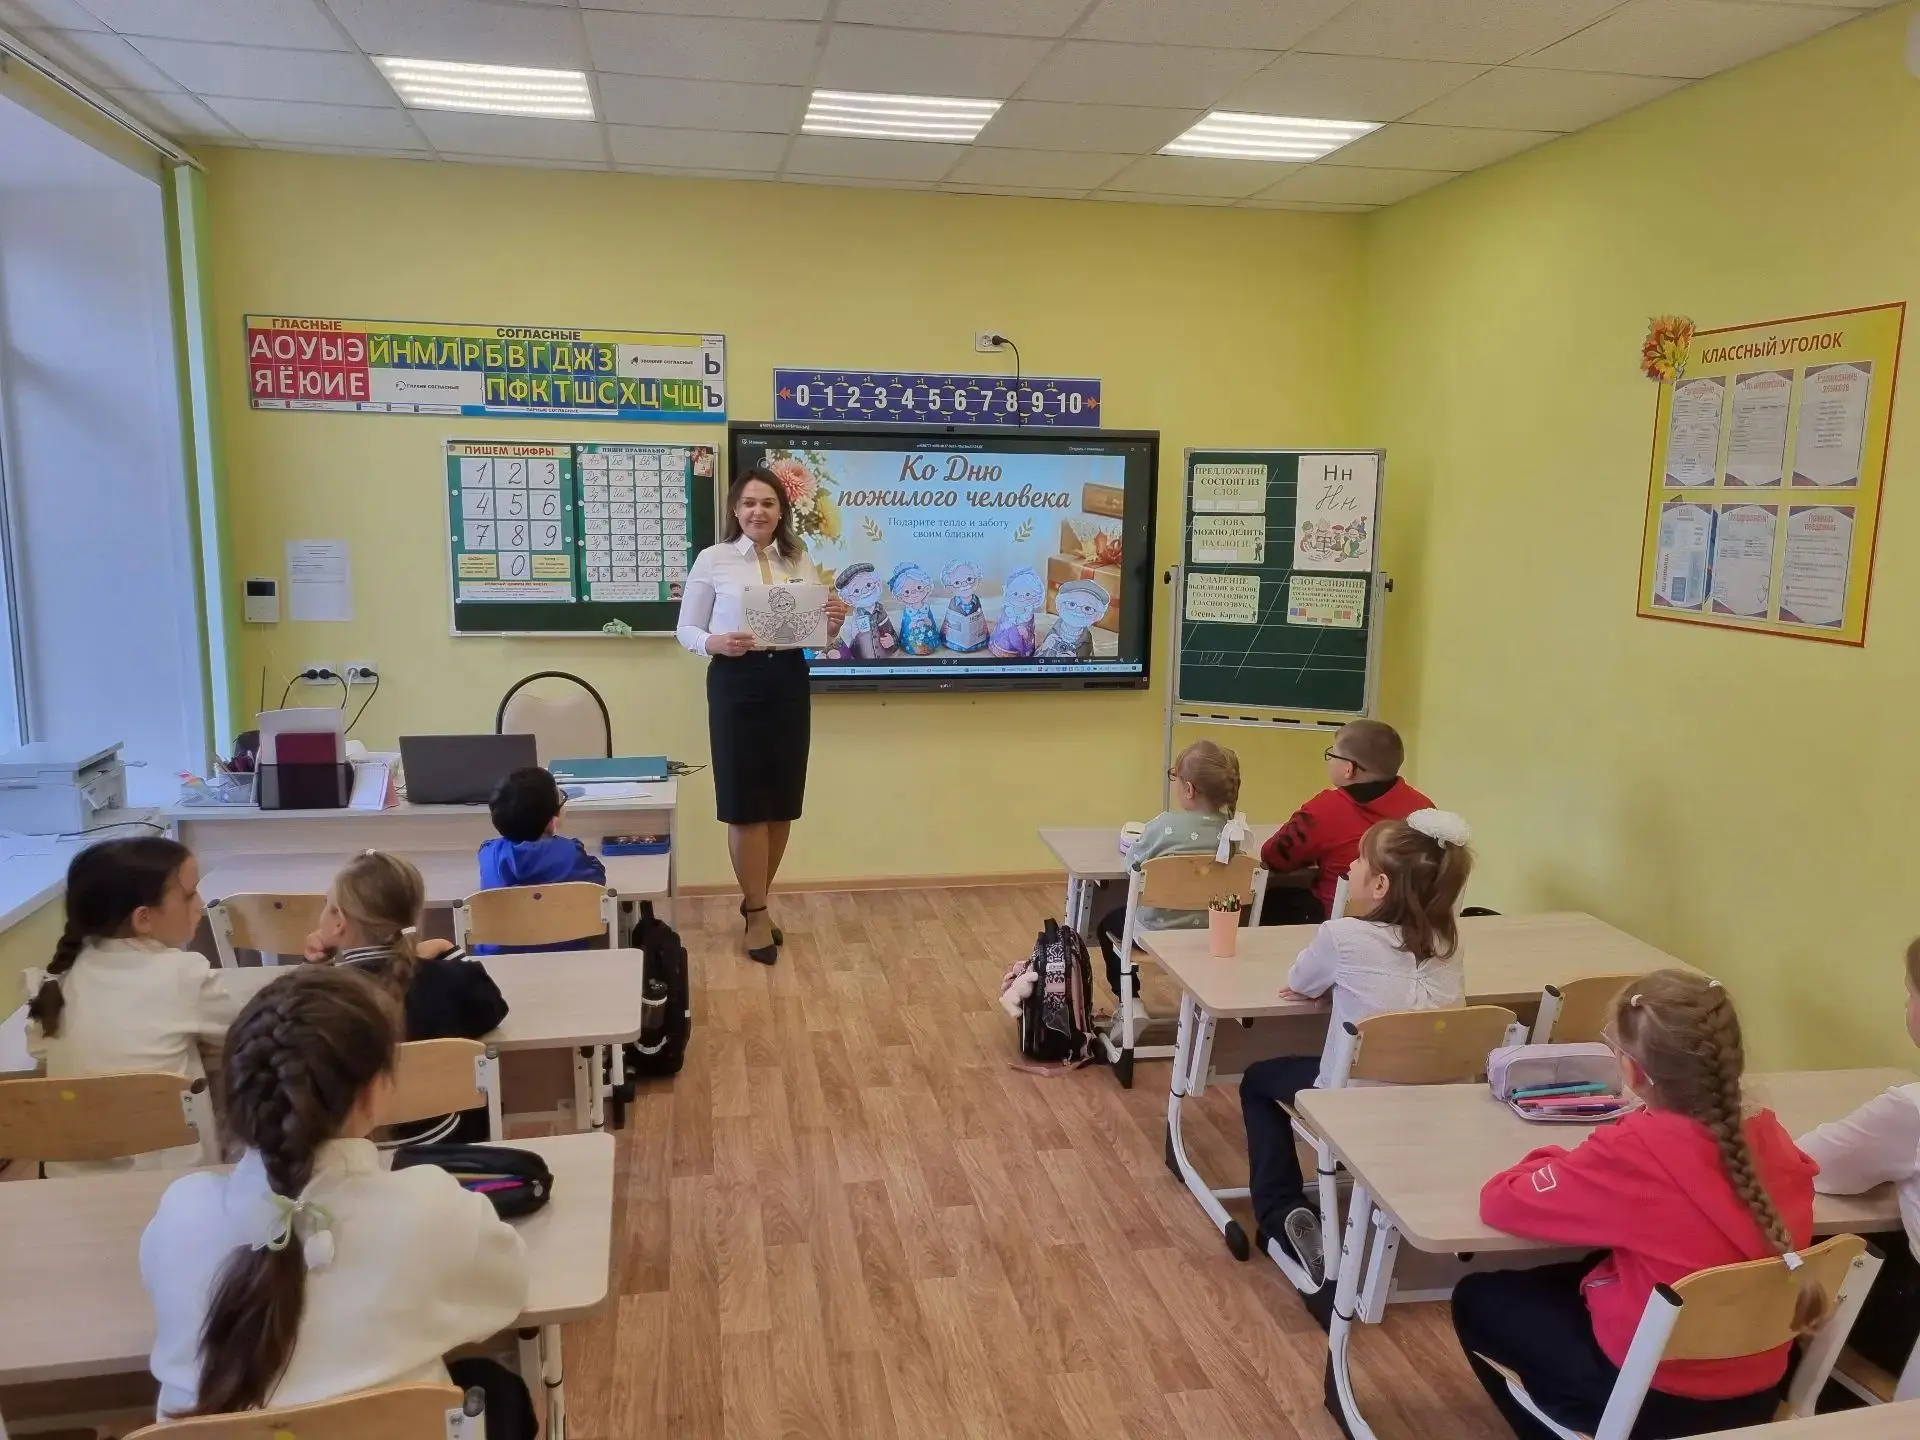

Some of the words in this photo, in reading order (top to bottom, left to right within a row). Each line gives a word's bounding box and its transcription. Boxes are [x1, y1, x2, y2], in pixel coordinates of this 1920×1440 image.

[272, 318, 342, 331] ГЛАСНЫЕ
[496, 327, 581, 341] СОГЛАСНЫЕ
[1701, 336, 1777, 364] КЛАССНЫЙ
[1780, 331, 1844, 355] УГОЛОК
[796, 384, 810, 406] 0
[823, 386, 833, 406] 1
[847, 386, 860, 408] 2
[874, 387, 887, 408] 3
[901, 388, 915, 409] 4
[928, 388, 941, 410] 5
[954, 389, 967, 411] 6
[980, 391, 993, 411] 7
[1006, 391, 1018, 412] 8
[1031, 392, 1044, 413] 9
[1057, 392, 1082, 413] 10
[464, 446, 509, 456] ПИШЕМ
[513, 446, 554, 457] ЦИФРЫ
[476, 461, 488, 484] 1
[508, 462, 522, 485] 2
[543, 462, 556, 485] 3
[899, 455, 938, 482] Ко
[943, 455, 1003, 482] Дню
[1194, 466, 1267, 476] ПРЕДЛОЖЕНИЕ
[1200, 478, 1247, 486] СОСТОИТ
[1247, 478, 1260, 486] ИЗ
[837, 489, 958, 508] пожилого
[966, 483, 1071, 508] человека
[476, 492, 490, 515] 4
[509, 493, 523, 516] 5
[542, 494, 557, 516] 6
[888, 517, 936, 529] Подарите
[938, 519, 967, 528] тепло
[979, 517, 1009, 529] заботу
[1213, 518, 1245, 526] СЛОВА
[476, 524, 490, 546] 7
[511, 524, 524, 546] 8
[543, 525, 557, 547] 9
[913, 530, 942, 538] своим
[944, 528, 985, 539] близким
[1193, 528, 1228, 536] МОЖНО
[1228, 528, 1264, 537] ДЕЛИТЬ
[511, 554, 526, 577] 0
[1199, 575, 1249, 585] УДАРЕНИЕ
